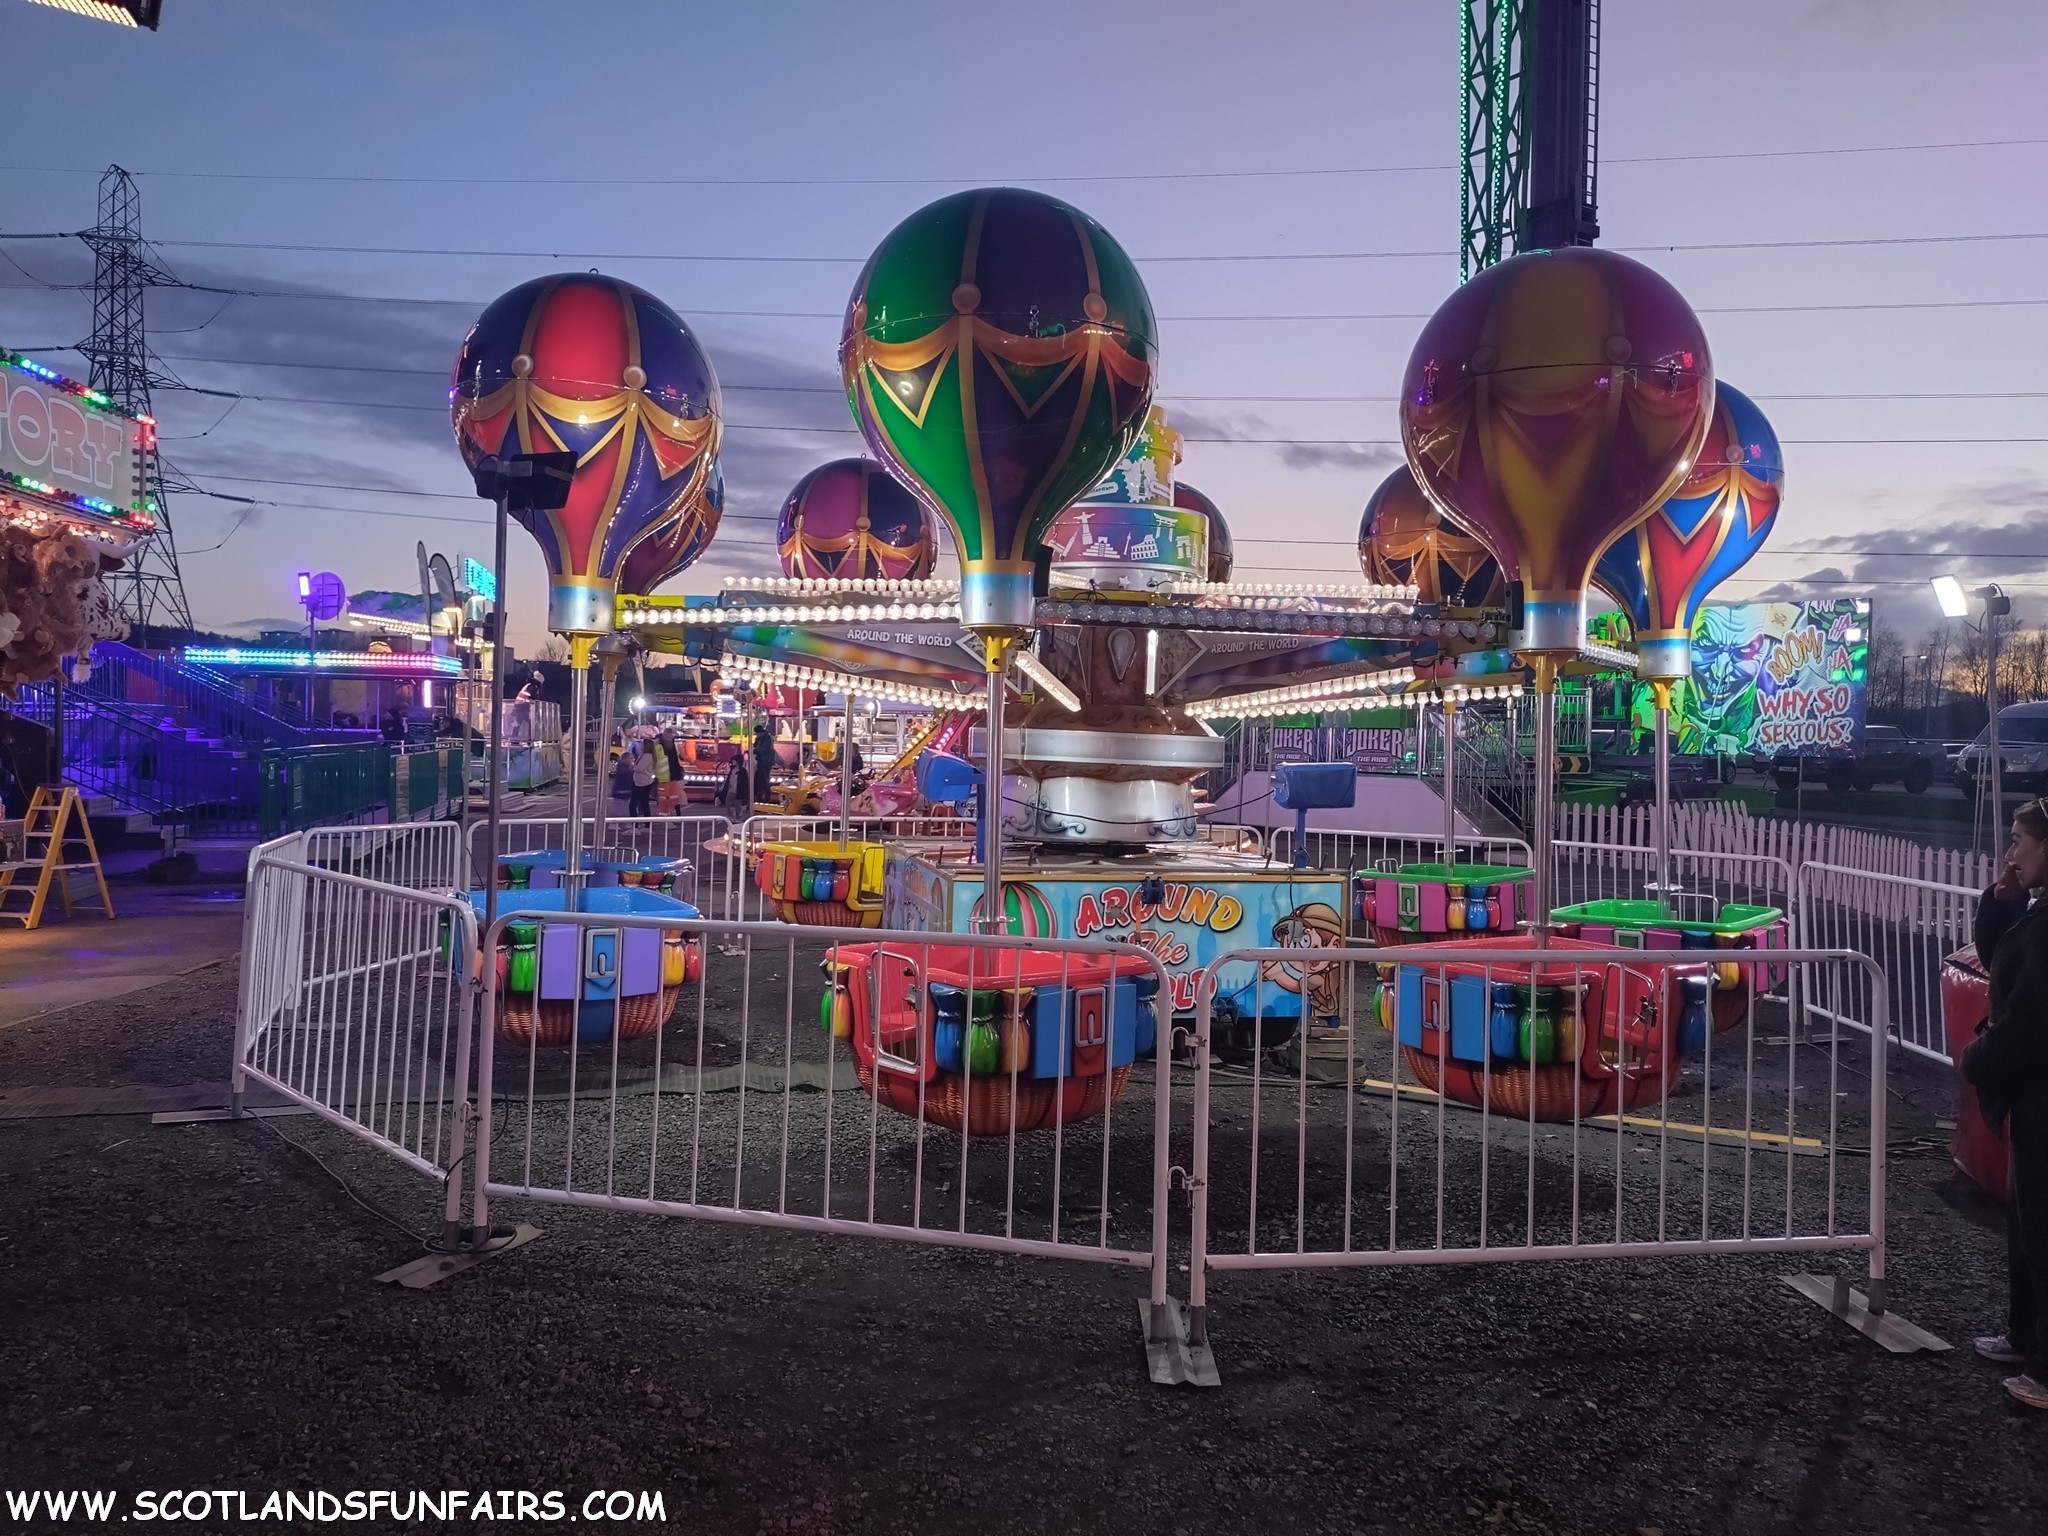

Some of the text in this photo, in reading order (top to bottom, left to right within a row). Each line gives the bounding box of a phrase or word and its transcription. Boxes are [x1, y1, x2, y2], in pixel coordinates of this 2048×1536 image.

[847, 629, 952, 647] AROUND THE WORLD
[1211, 637, 1299, 654] AROUND THE WORLD
[1767, 626, 1825, 683] BOOM!
[1758, 686, 1850, 718] WHY SO
[1347, 728, 1403, 758] JOKER
[1760, 720, 1854, 748] SERIOUS?
[1076, 883, 1243, 938] AROUND
